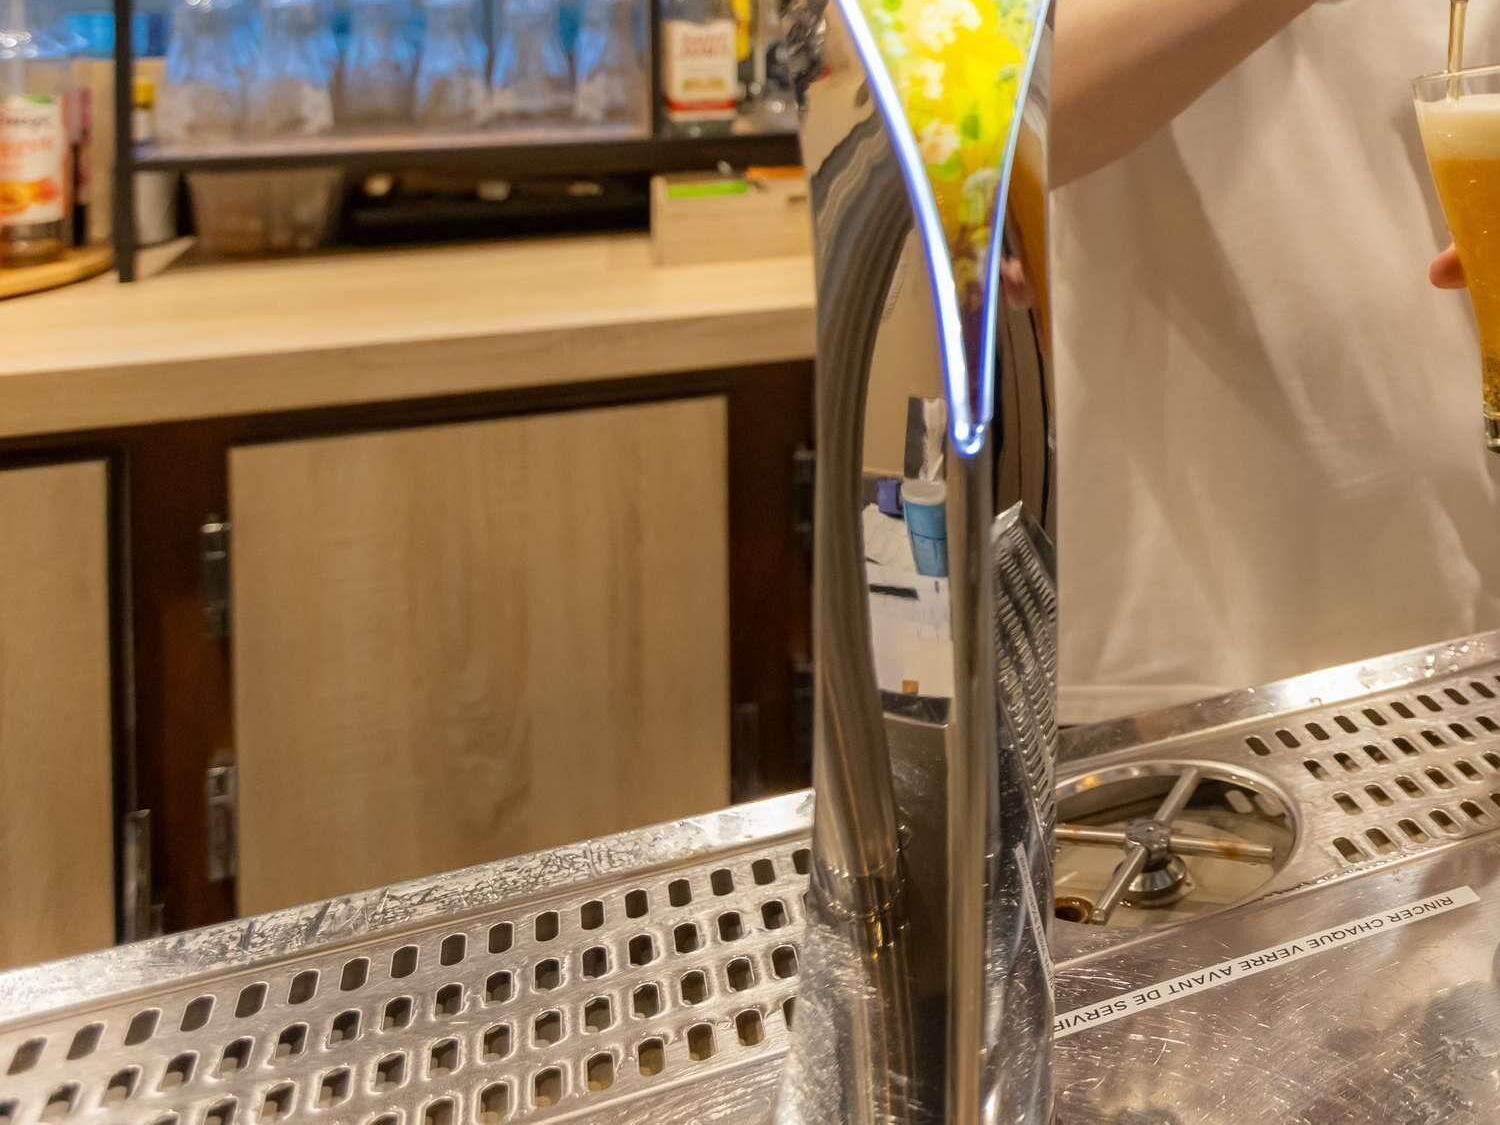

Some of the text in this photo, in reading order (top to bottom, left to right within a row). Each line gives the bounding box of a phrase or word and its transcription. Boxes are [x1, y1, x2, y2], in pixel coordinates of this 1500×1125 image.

[1388, 896, 1453, 923] RINCER
[1306, 918, 1384, 947] CHAQUE
[1240, 944, 1303, 971] VERRE
[1166, 965, 1232, 994] AVANT
[1133, 989, 1161, 1007] DE
